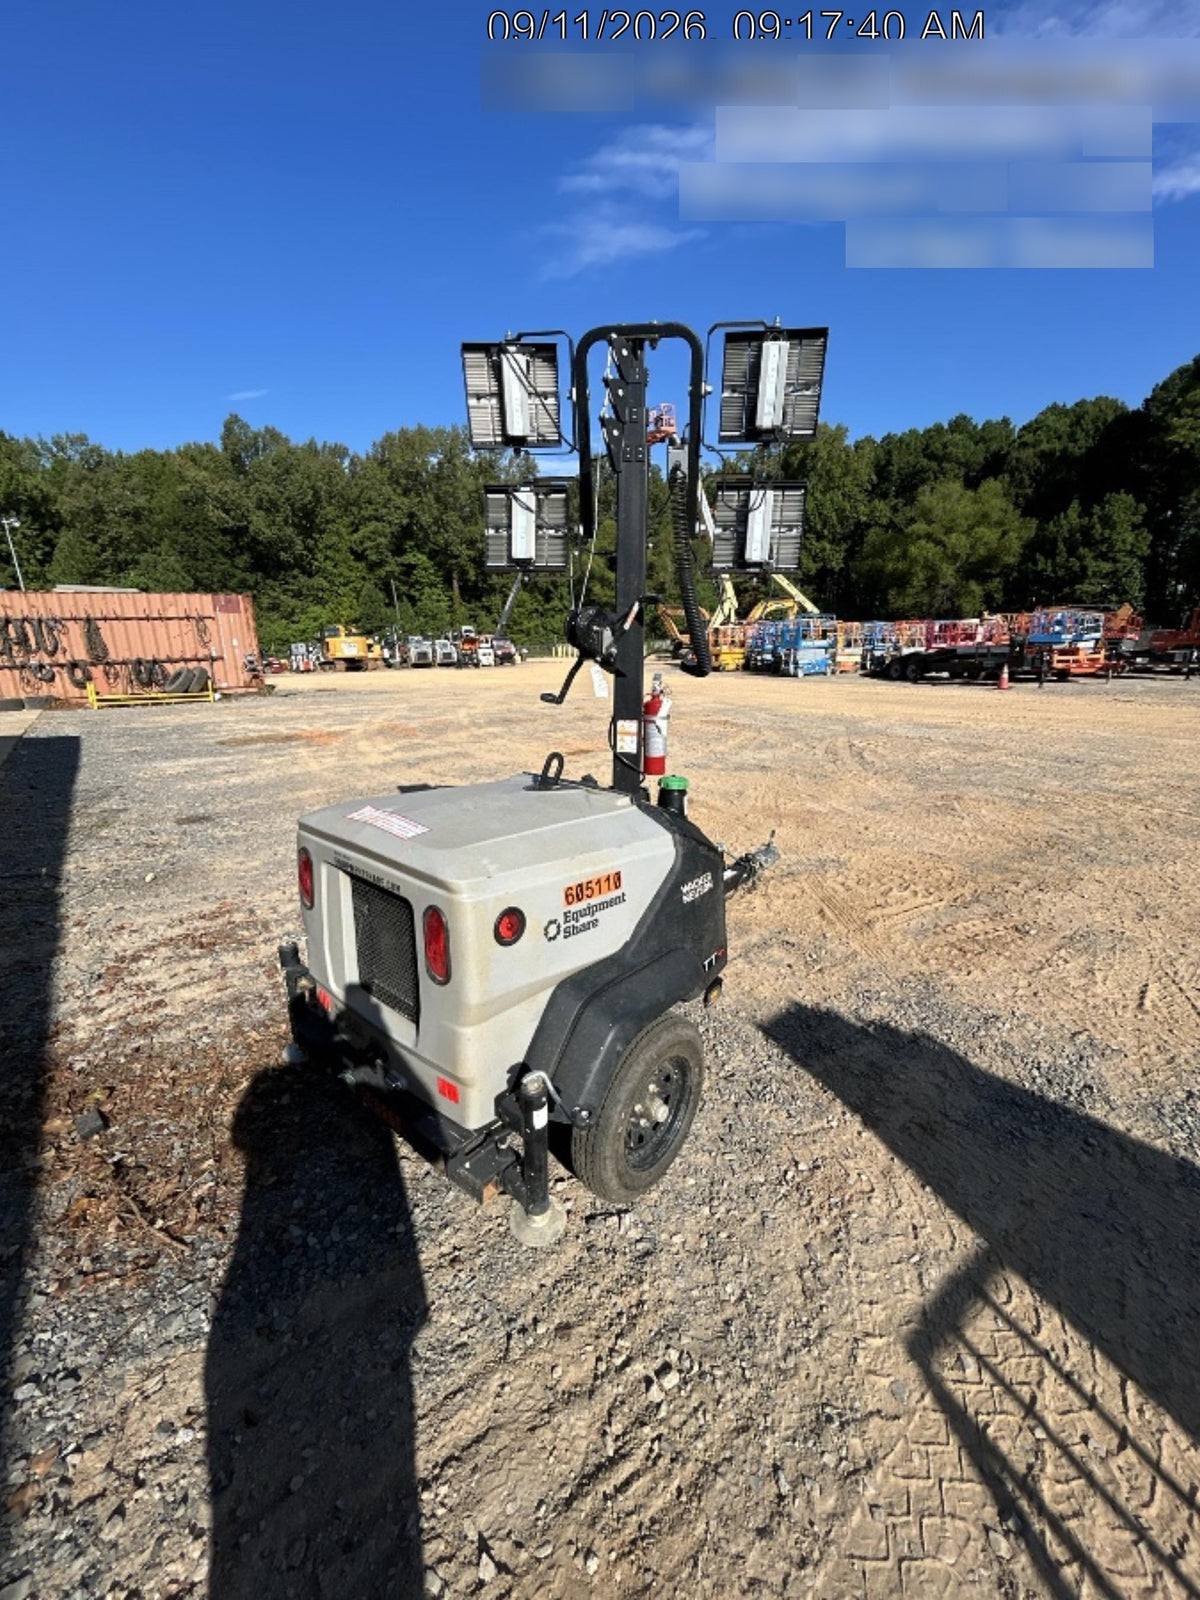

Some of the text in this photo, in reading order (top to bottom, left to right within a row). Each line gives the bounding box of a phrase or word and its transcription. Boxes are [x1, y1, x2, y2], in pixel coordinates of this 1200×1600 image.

[564, 871, 622, 906] 605110
[563, 892, 627, 924] Equipment
[563, 918, 599, 940] Share
